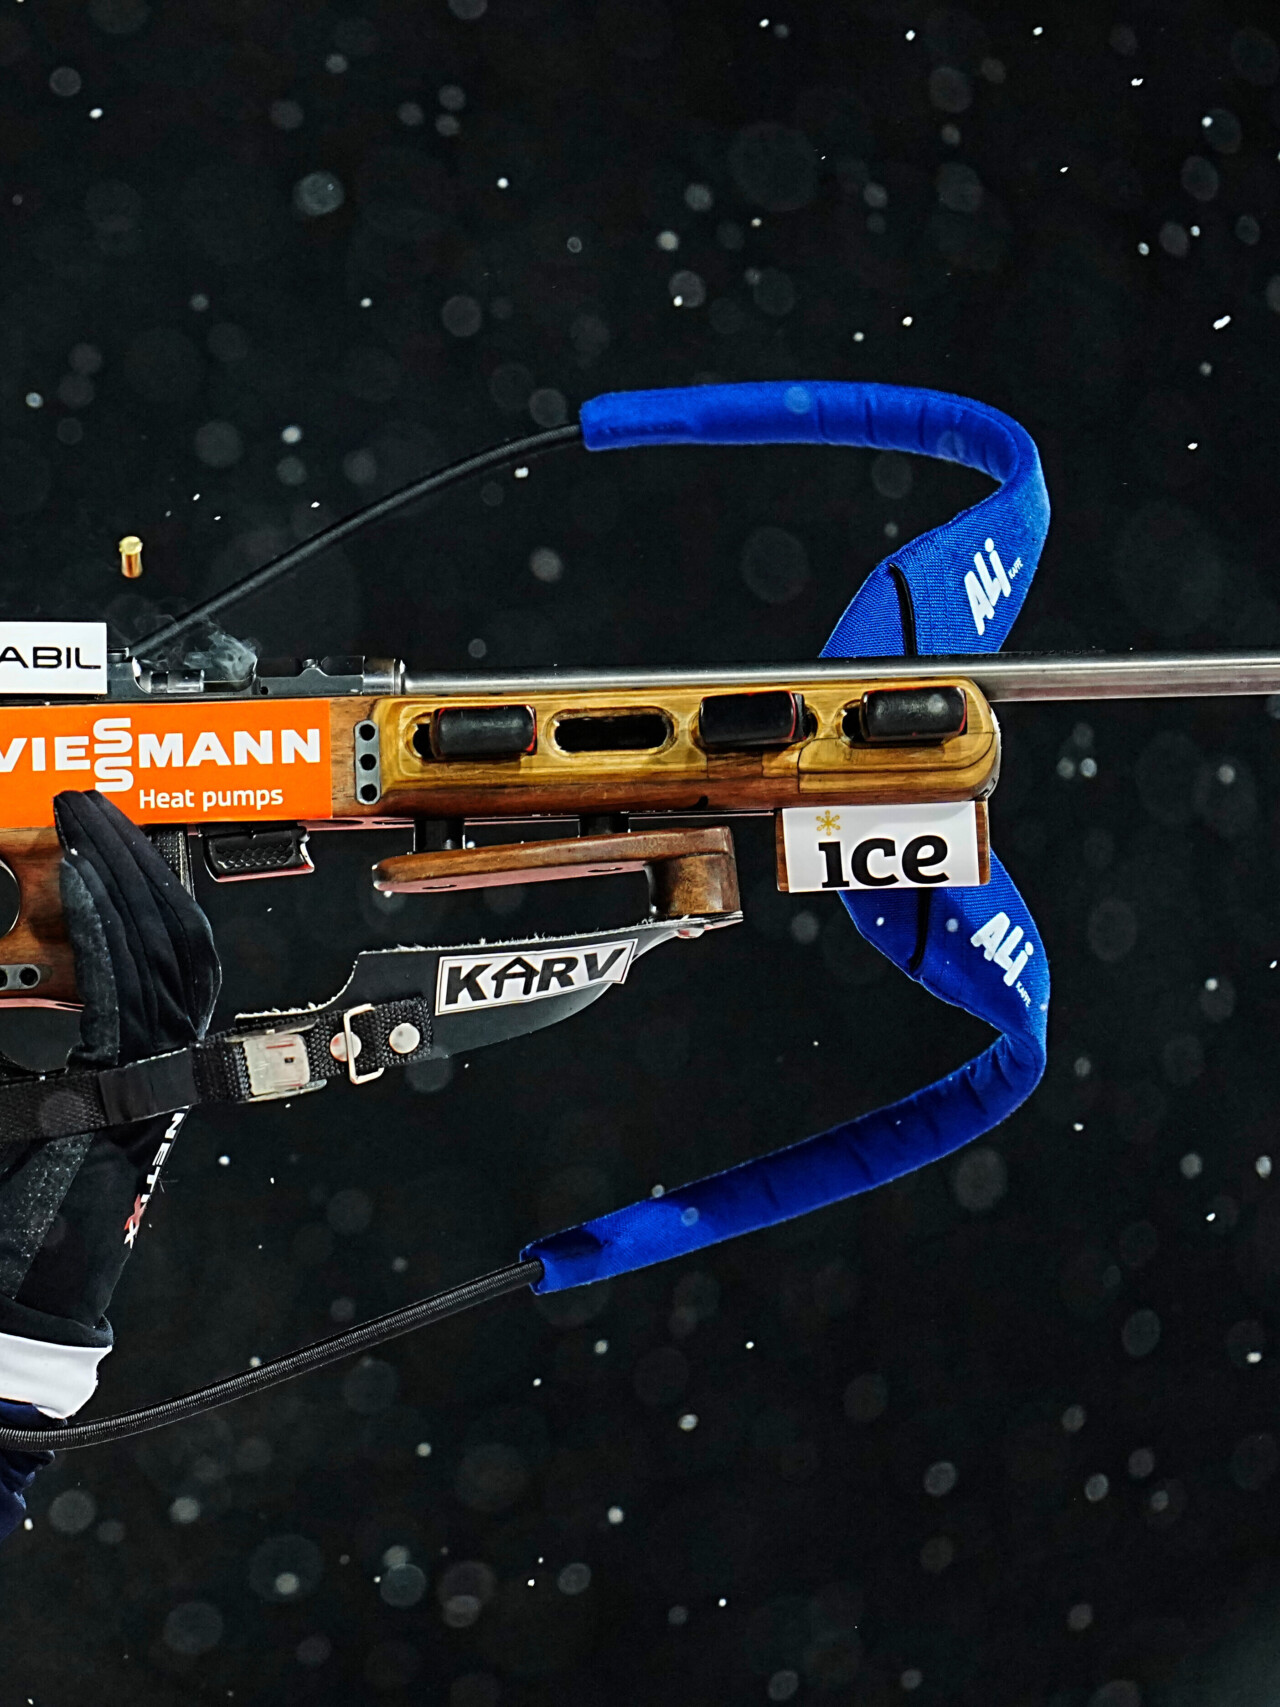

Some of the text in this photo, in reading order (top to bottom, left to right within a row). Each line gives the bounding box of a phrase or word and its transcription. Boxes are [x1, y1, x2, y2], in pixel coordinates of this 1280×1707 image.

[139, 788, 284, 812] Heat pumps
[817, 834, 951, 889] ice
[444, 947, 627, 1006] KARV
